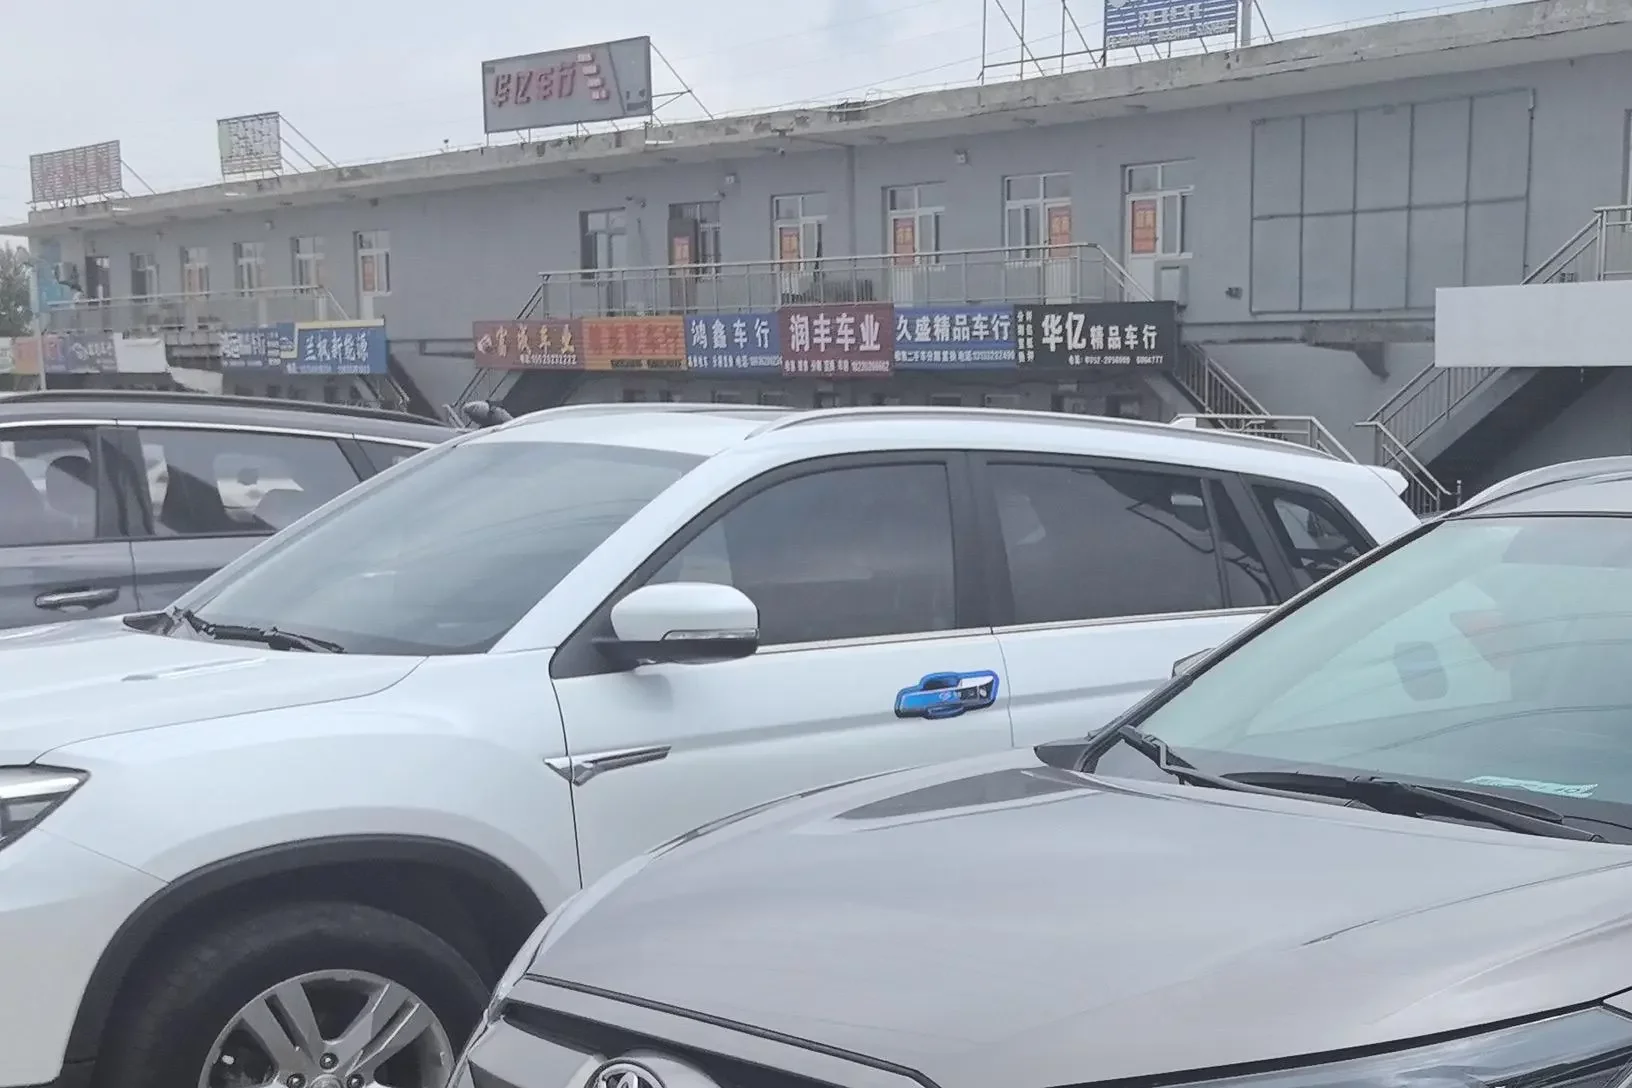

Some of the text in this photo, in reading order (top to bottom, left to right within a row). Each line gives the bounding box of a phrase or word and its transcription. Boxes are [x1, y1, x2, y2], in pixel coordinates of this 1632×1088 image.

[790, 313, 880, 352] 润丰车业
[896, 314, 1010, 342] 久盛精品车行
[1042, 312, 1086, 351] 华亿
[1090, 325, 1157, 350] 精品车行
